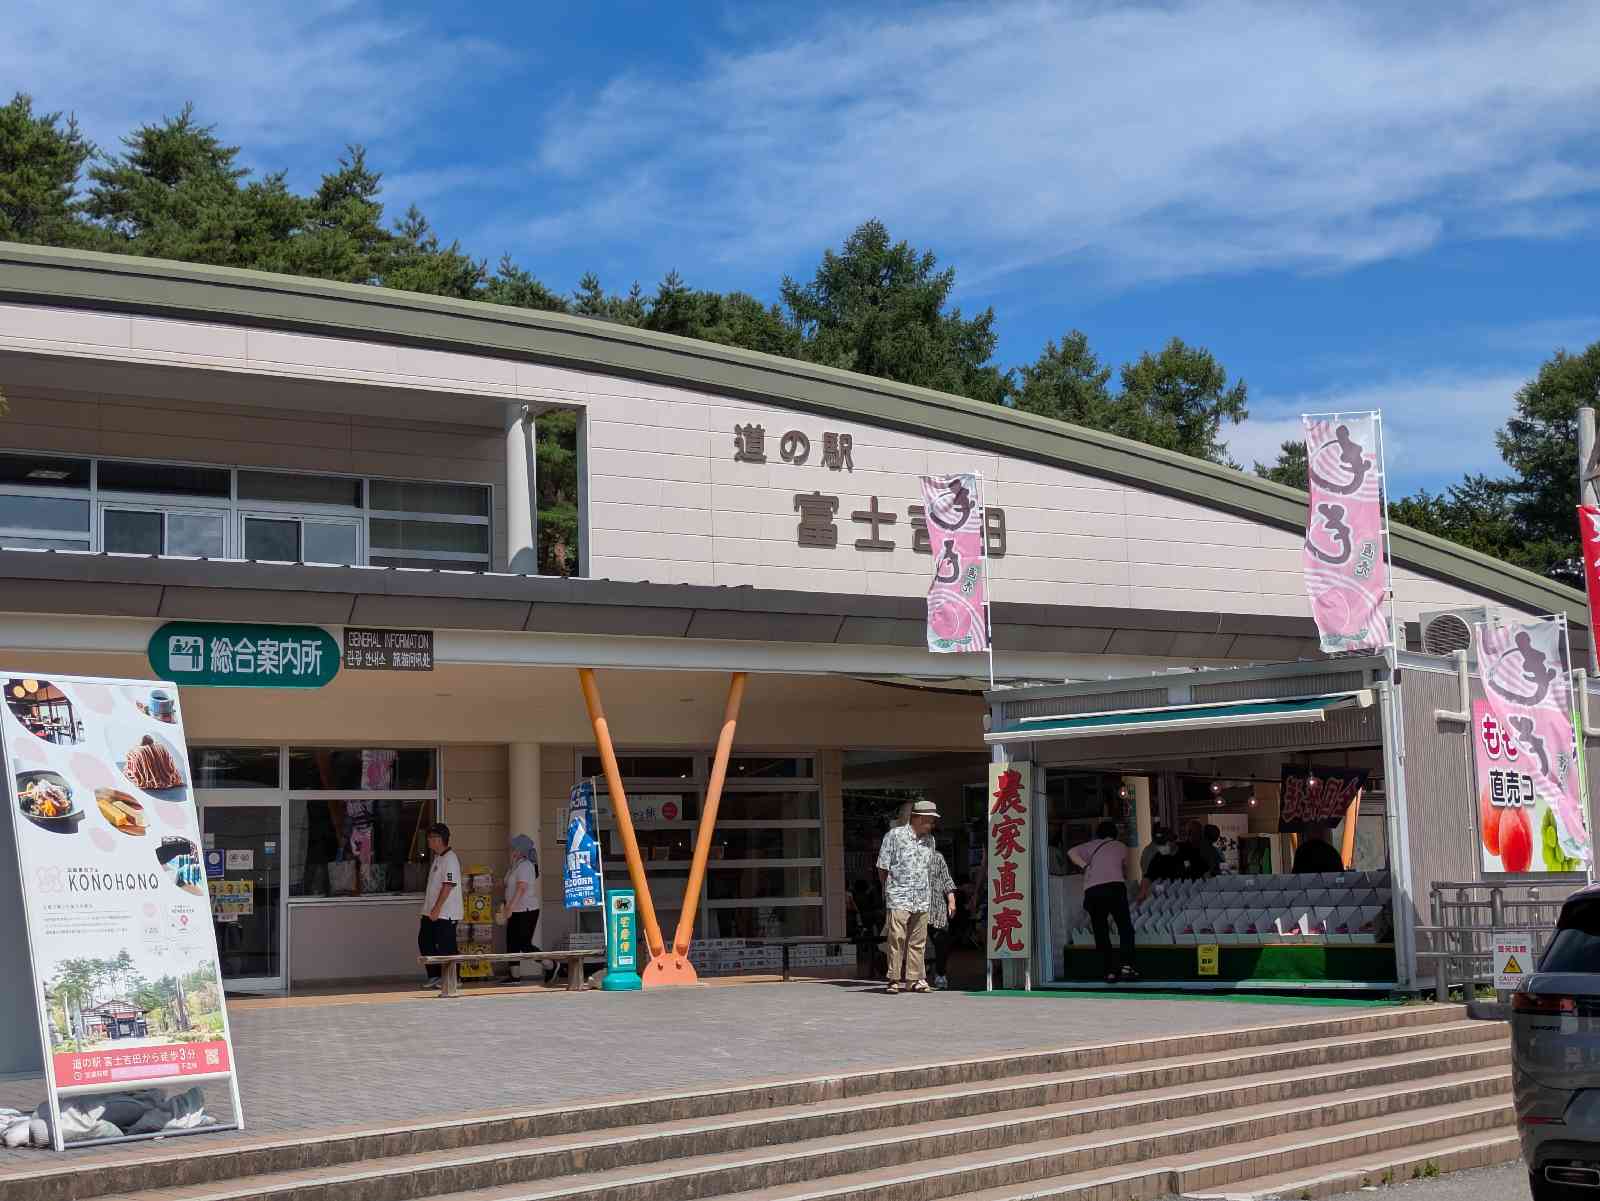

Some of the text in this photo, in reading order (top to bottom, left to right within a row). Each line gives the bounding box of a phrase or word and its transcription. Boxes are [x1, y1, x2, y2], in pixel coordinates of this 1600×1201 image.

[734, 422, 854, 473] 道の駅
[210, 636, 322, 676] 総合案内所
[348, 631, 429, 649] GENERAL INFORMATION
[990, 769, 1027, 953] 農家直売
[68, 873, 159, 892] KONOHONO
